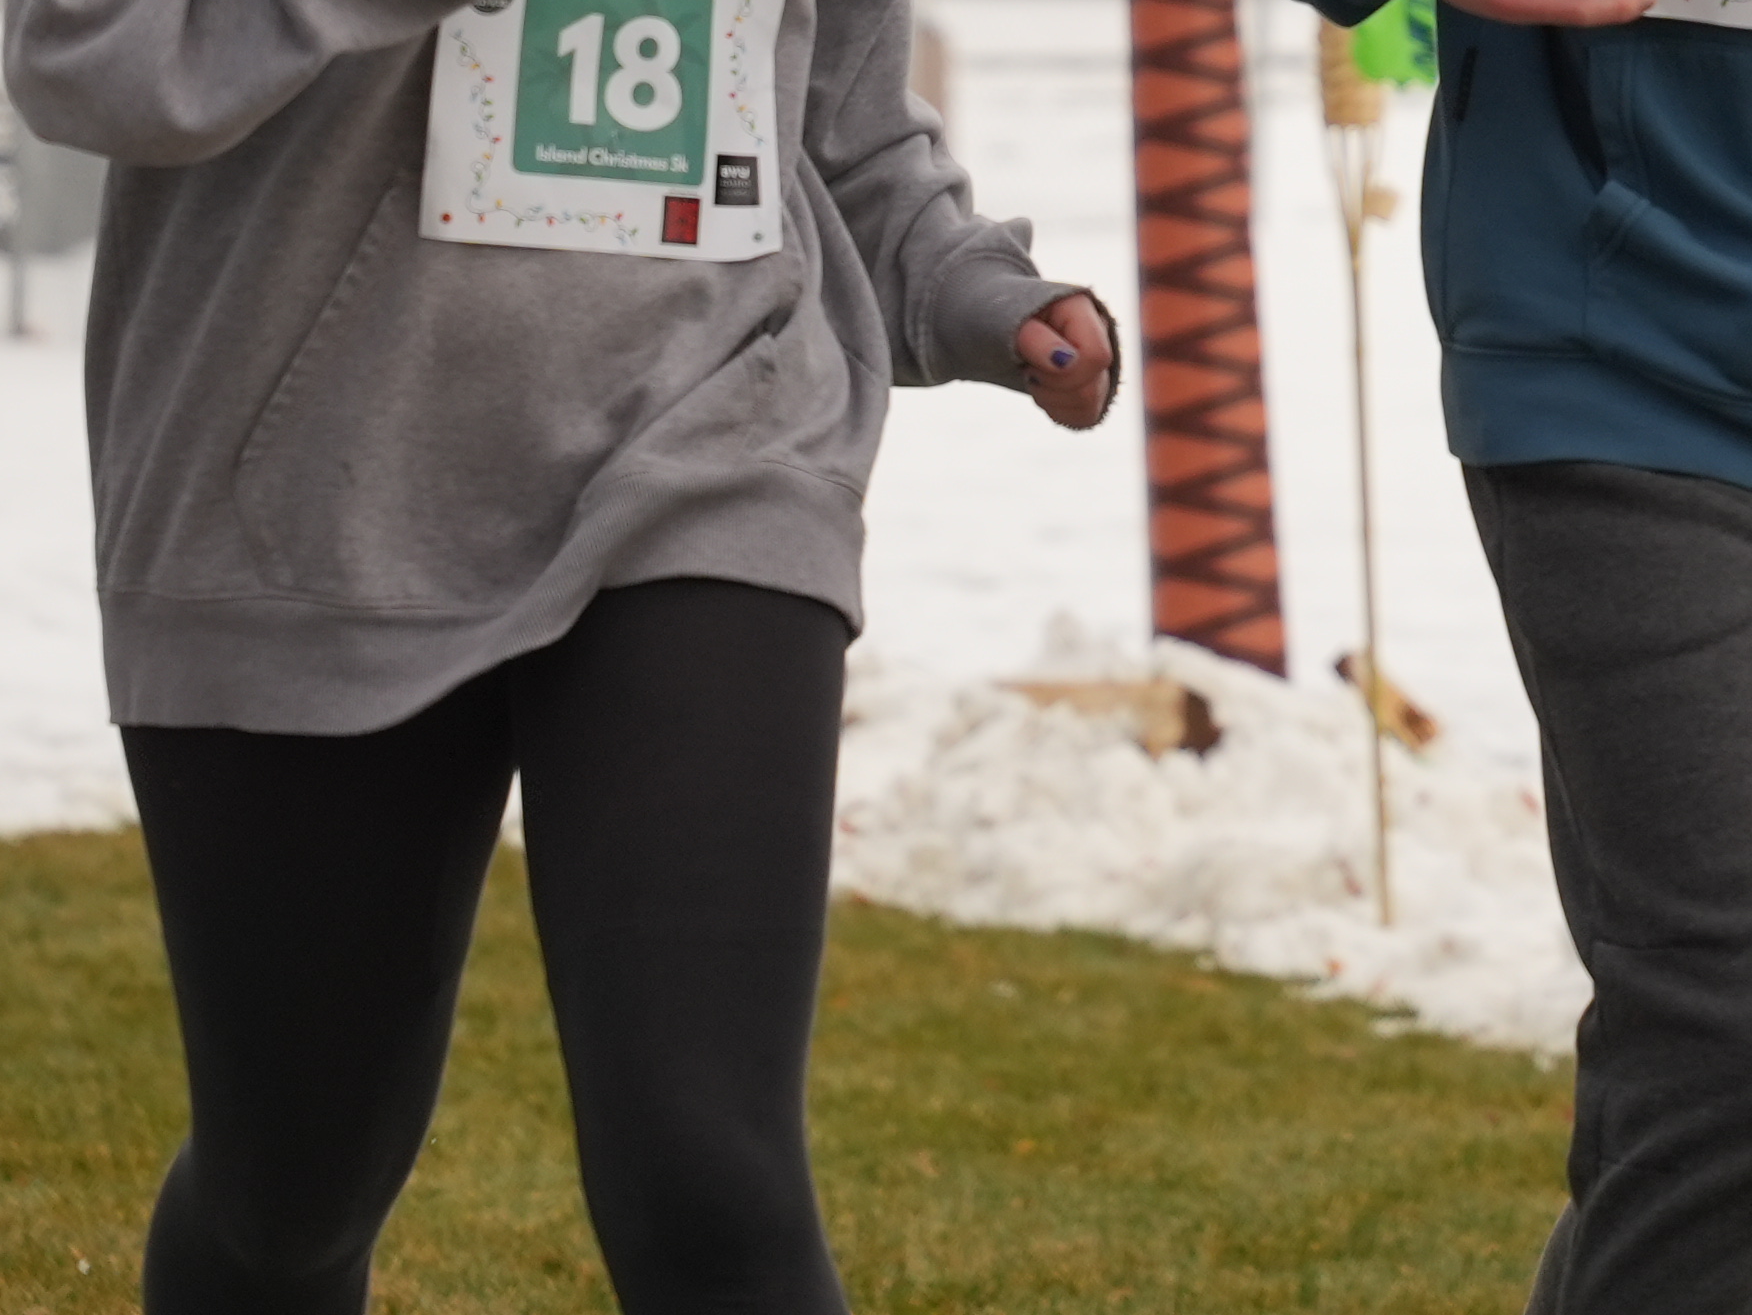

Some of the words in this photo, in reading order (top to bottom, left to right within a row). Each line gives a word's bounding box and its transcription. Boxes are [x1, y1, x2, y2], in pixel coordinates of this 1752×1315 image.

[557, 12, 683, 132] 18
[535, 143, 588, 165] Island
[588, 146, 669, 171] Christmas
